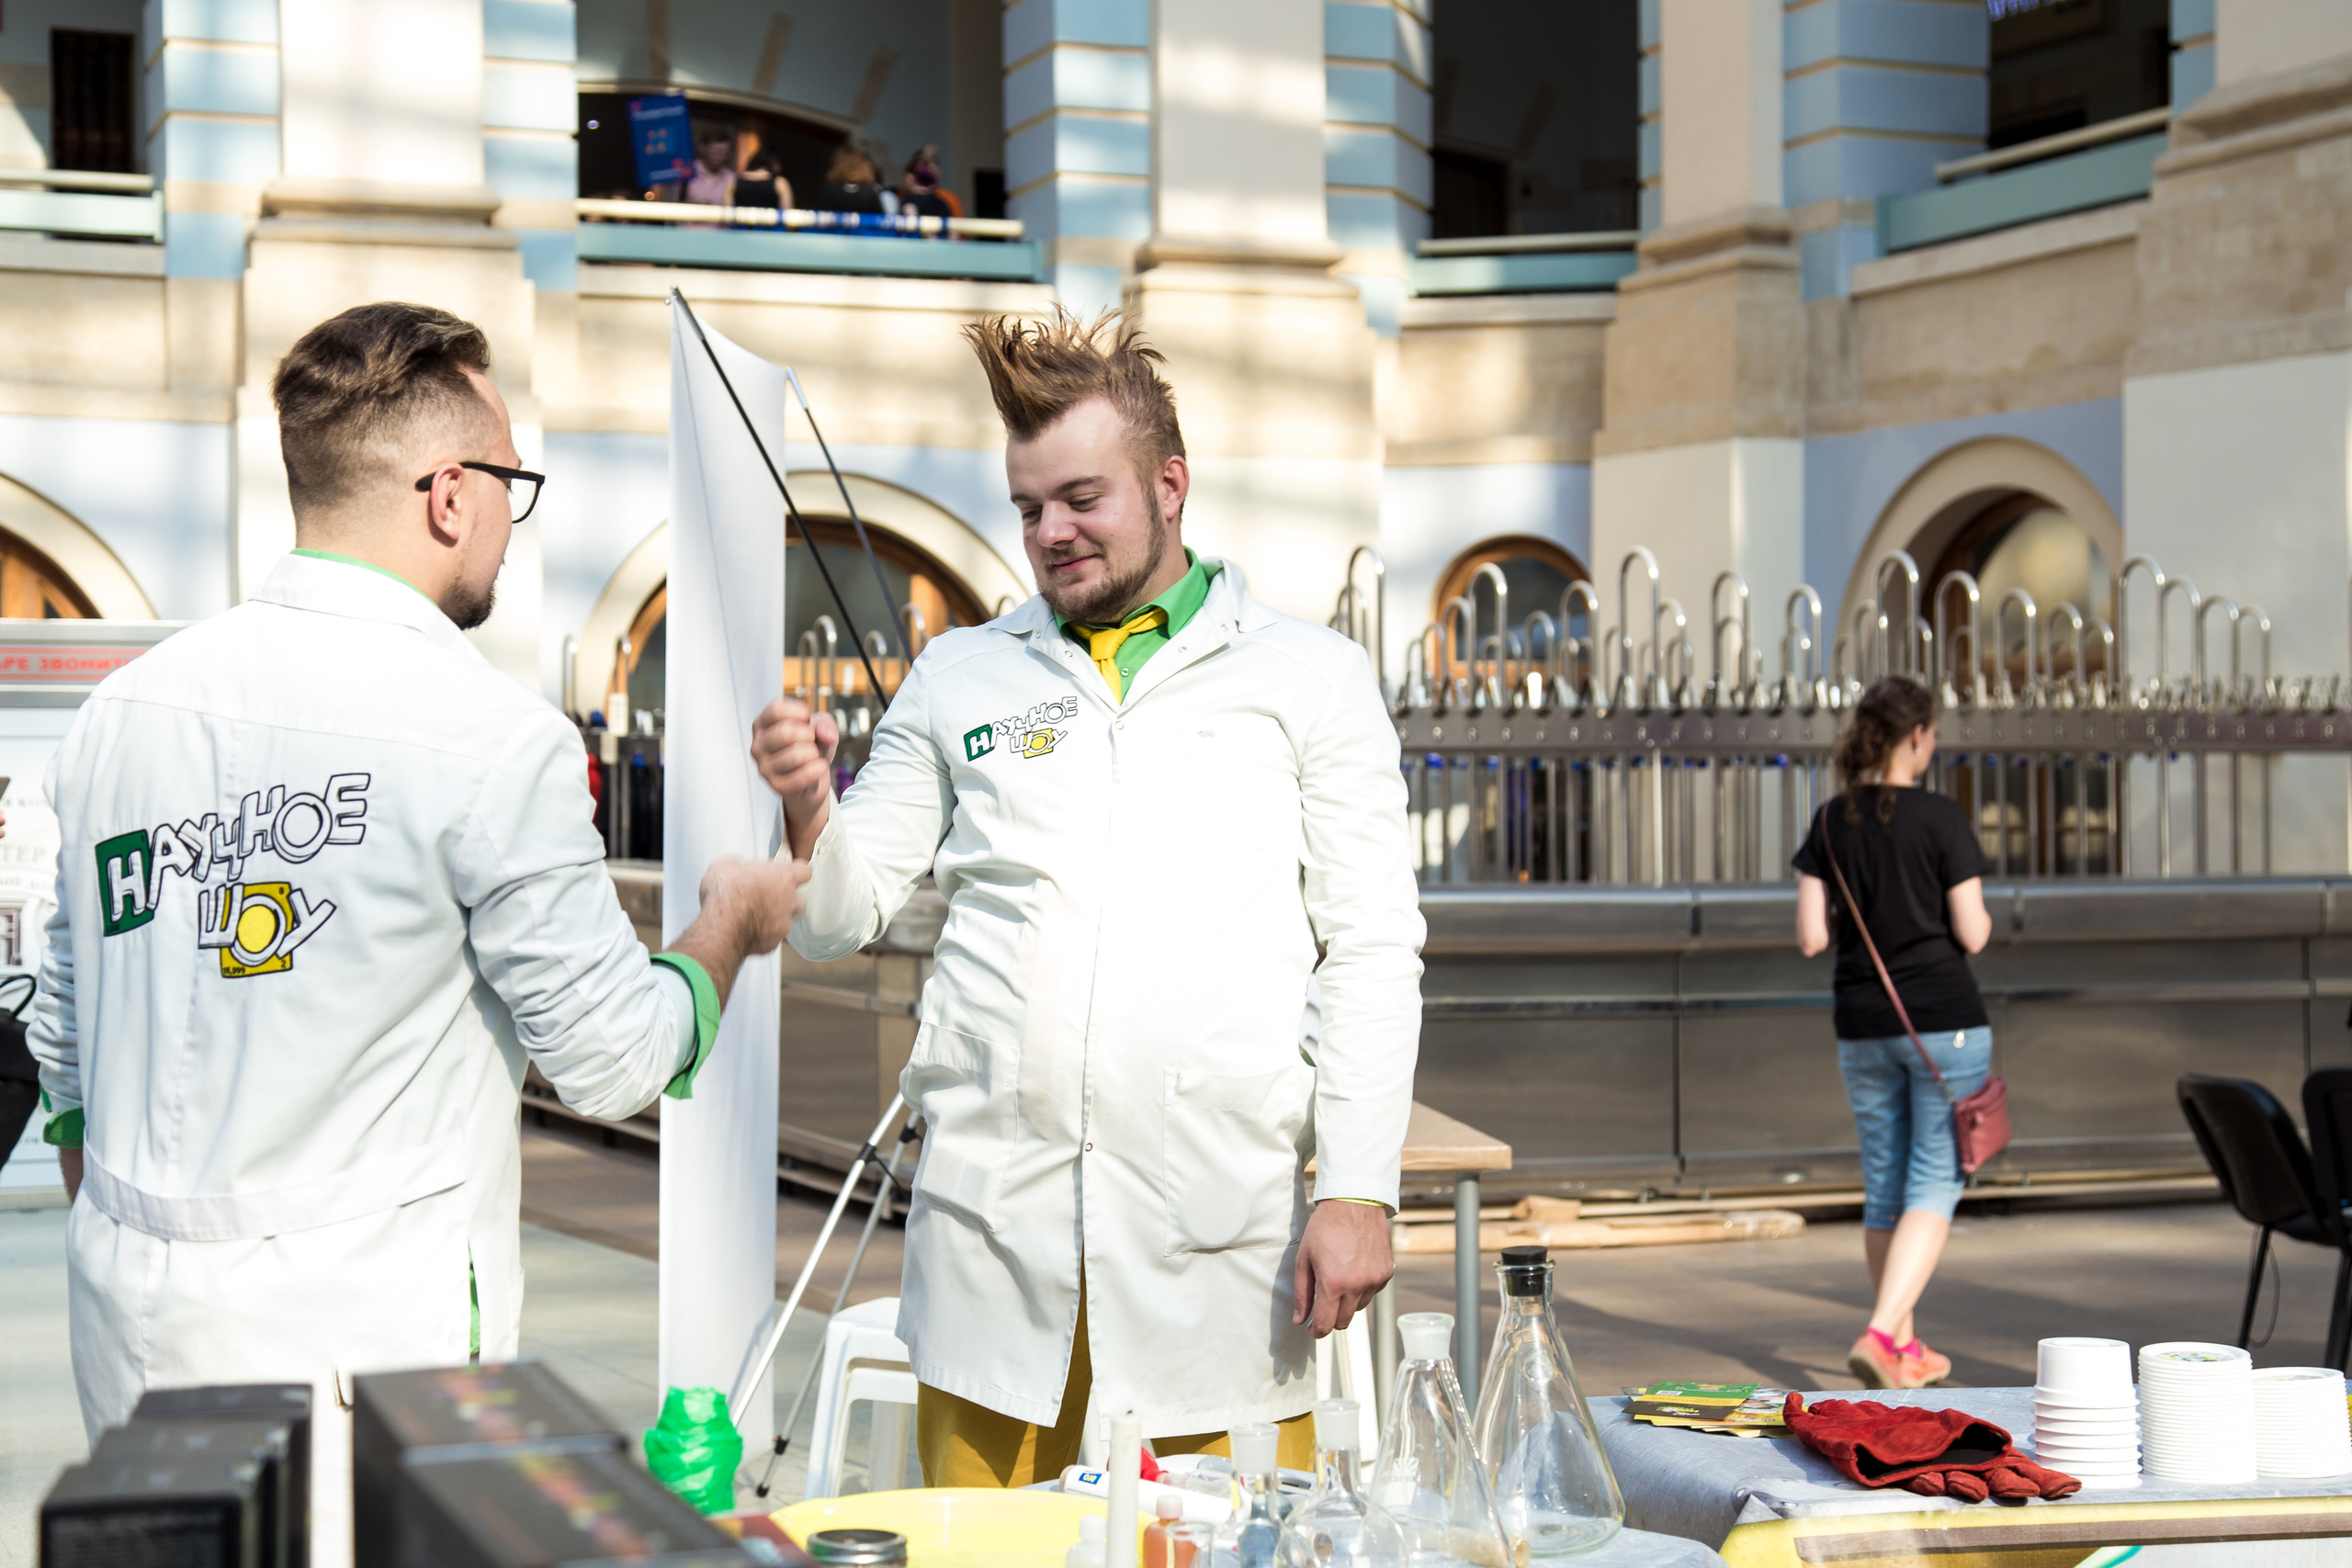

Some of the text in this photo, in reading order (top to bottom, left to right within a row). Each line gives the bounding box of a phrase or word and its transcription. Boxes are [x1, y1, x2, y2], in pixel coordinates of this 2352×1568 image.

[0, 656, 28, 670] РЕ
[966, 696, 1078, 758] НАУЧНОЕ
[1010, 729, 1068, 753] ШОУ
[99, 773, 370, 926] НАУЧНОЕ
[198, 882, 337, 967] ШОУ
